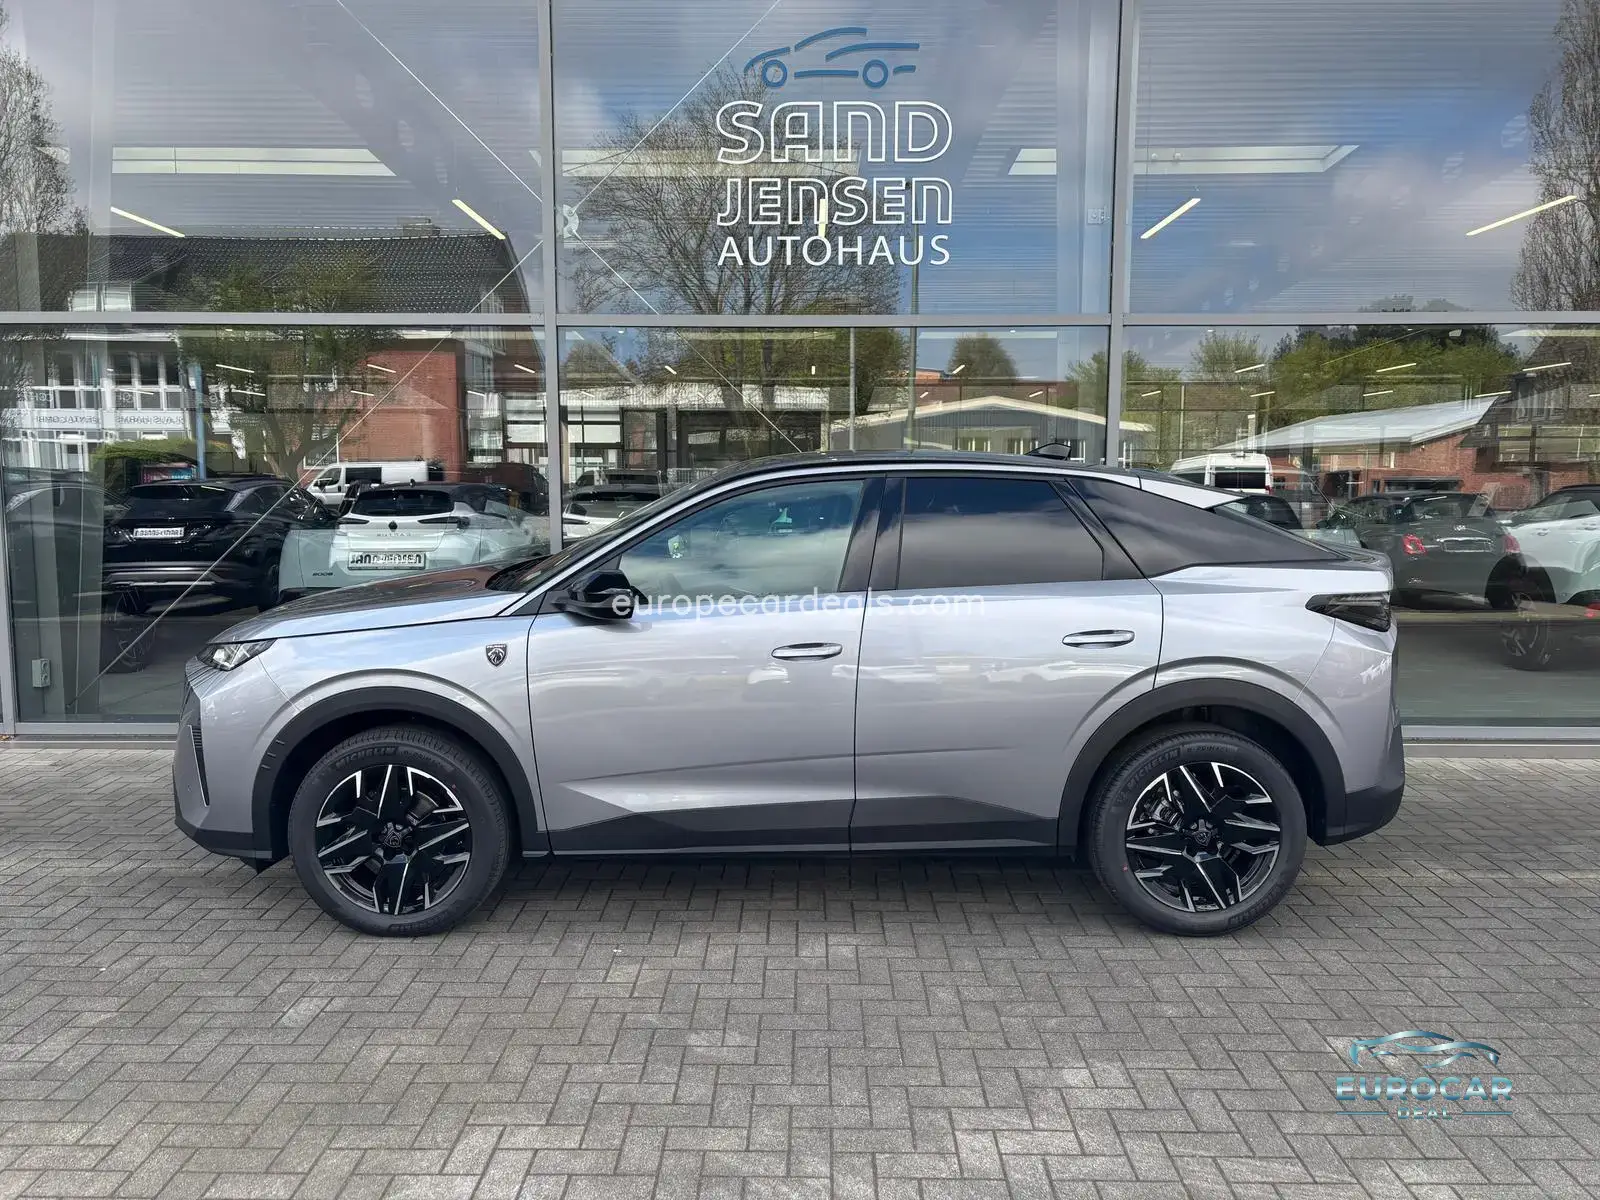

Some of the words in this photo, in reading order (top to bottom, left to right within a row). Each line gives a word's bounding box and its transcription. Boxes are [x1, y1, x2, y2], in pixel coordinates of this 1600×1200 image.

[715, 100, 953, 165] SAND
[716, 176, 953, 226] JENSEN
[717, 234, 950, 266] AUTOHAUS
